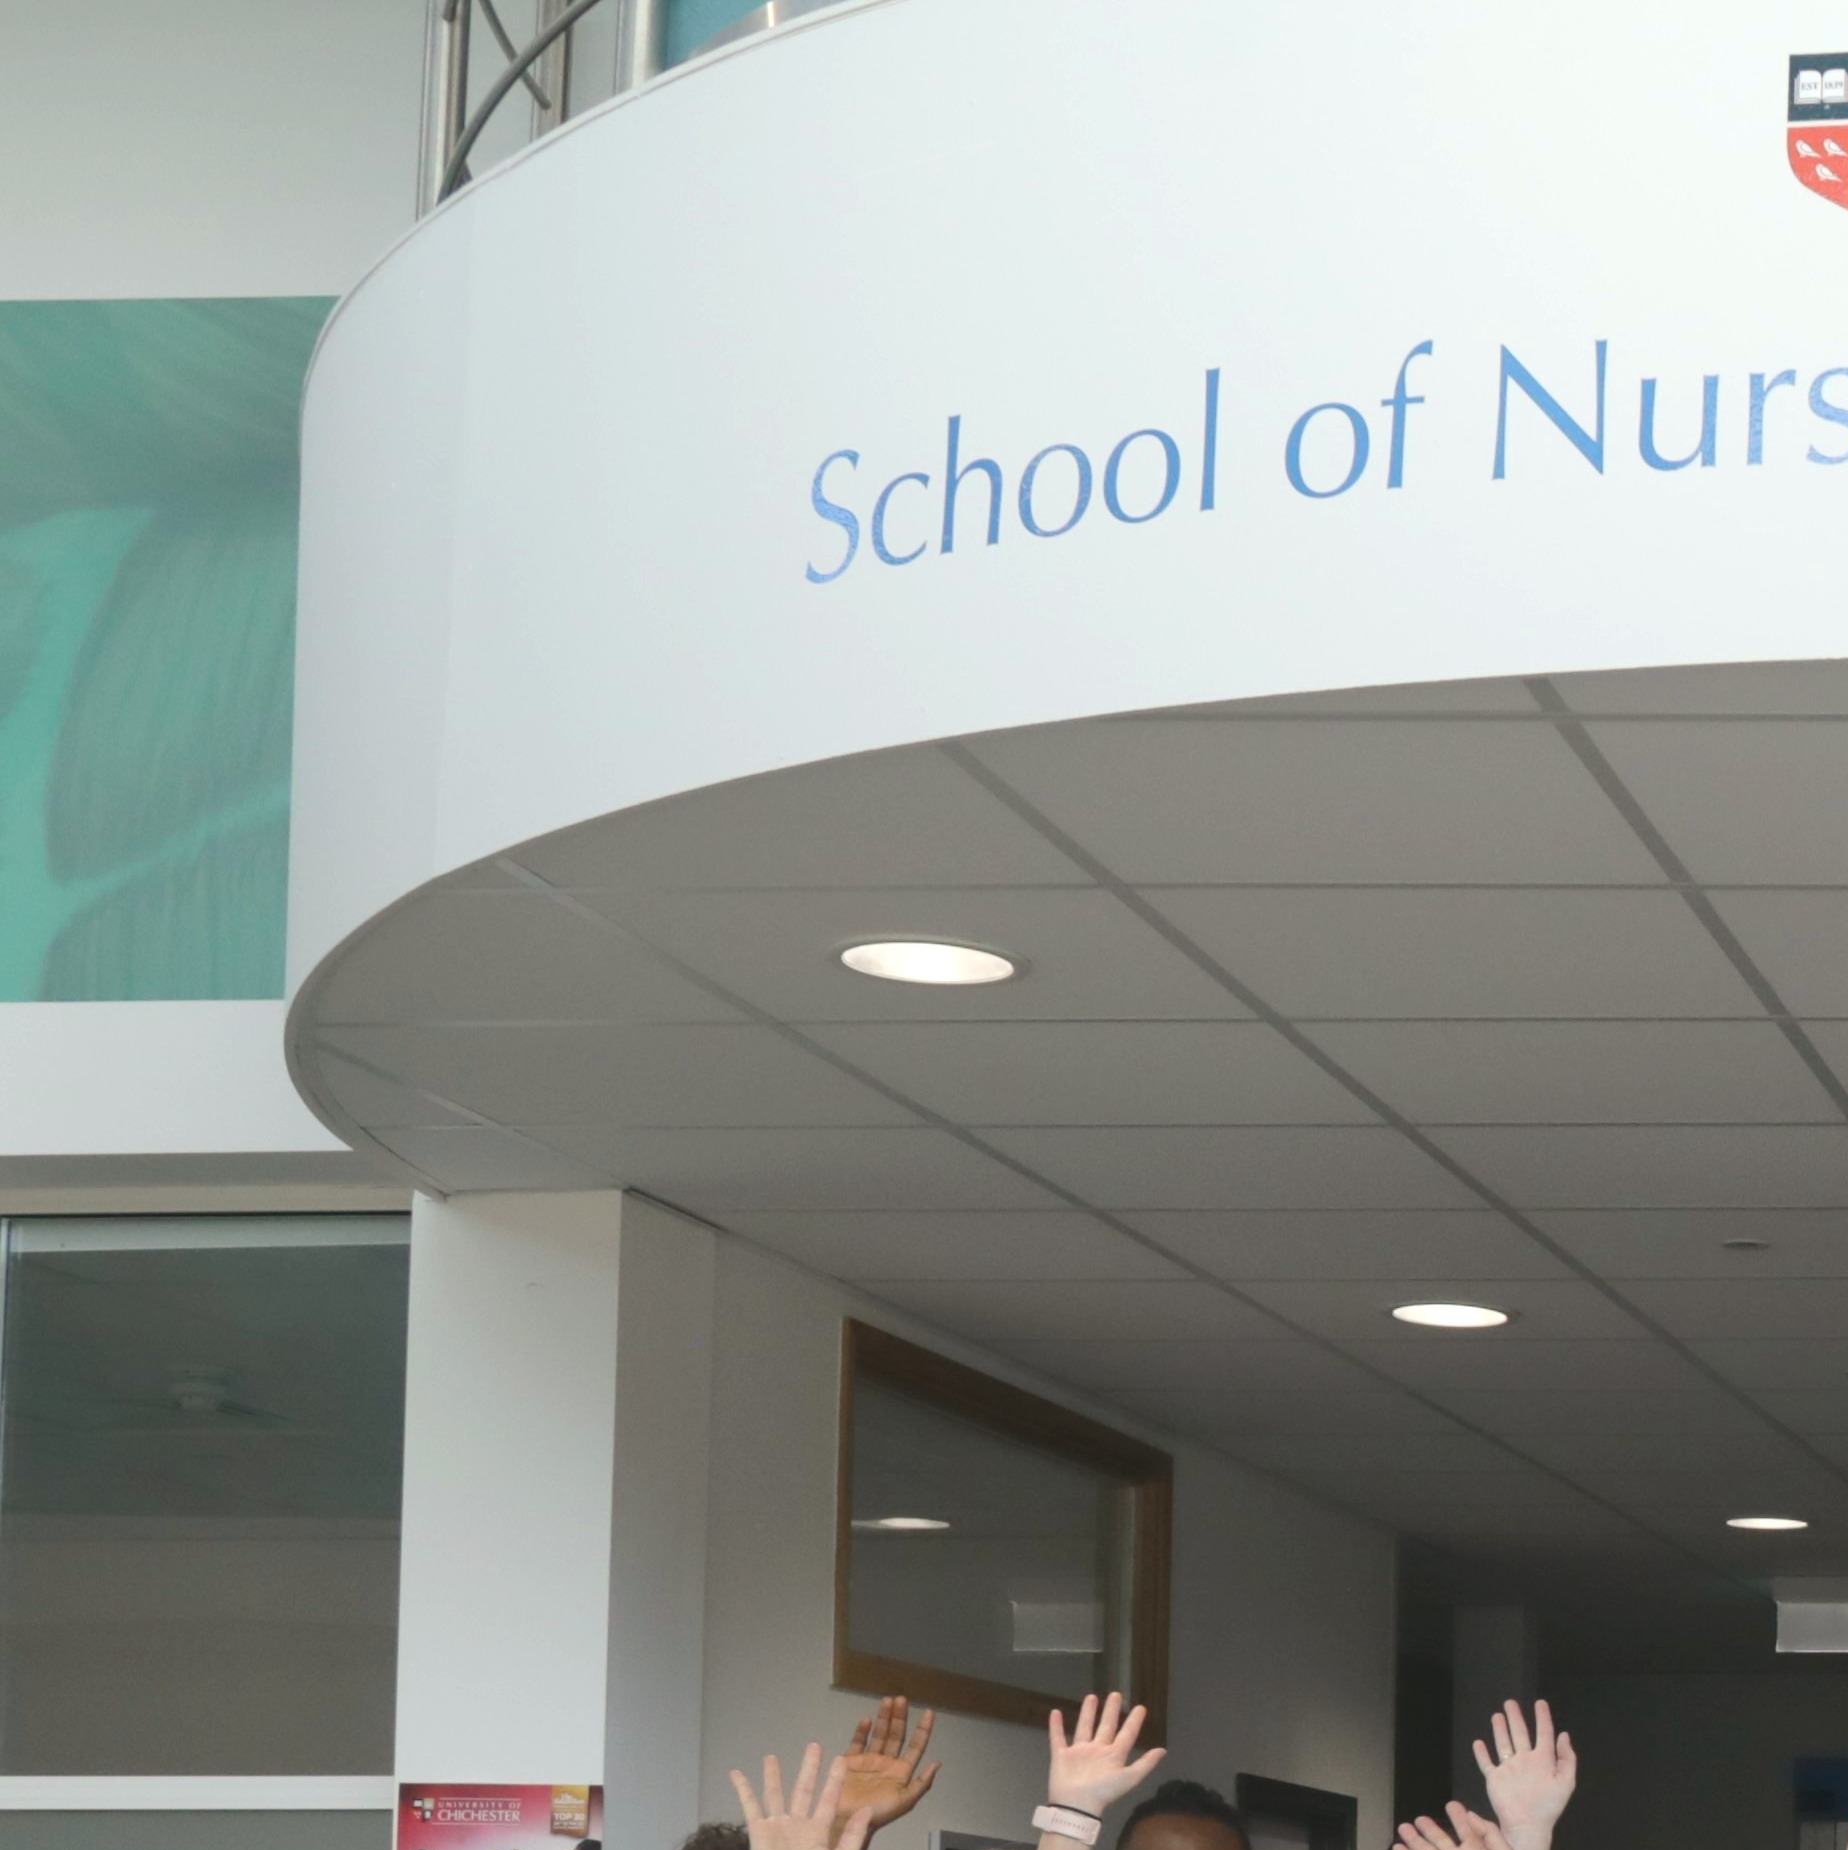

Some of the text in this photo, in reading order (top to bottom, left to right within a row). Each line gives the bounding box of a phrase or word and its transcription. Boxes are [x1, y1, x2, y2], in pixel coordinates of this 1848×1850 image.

[803, 368, 1222, 585] School
[1283, 338, 1435, 499] of
[438, 1801, 501, 1809] UNIVERSITY
[437, 1809, 520, 1822] CHICHESTER
[553, 1812, 572, 1821] TOP
